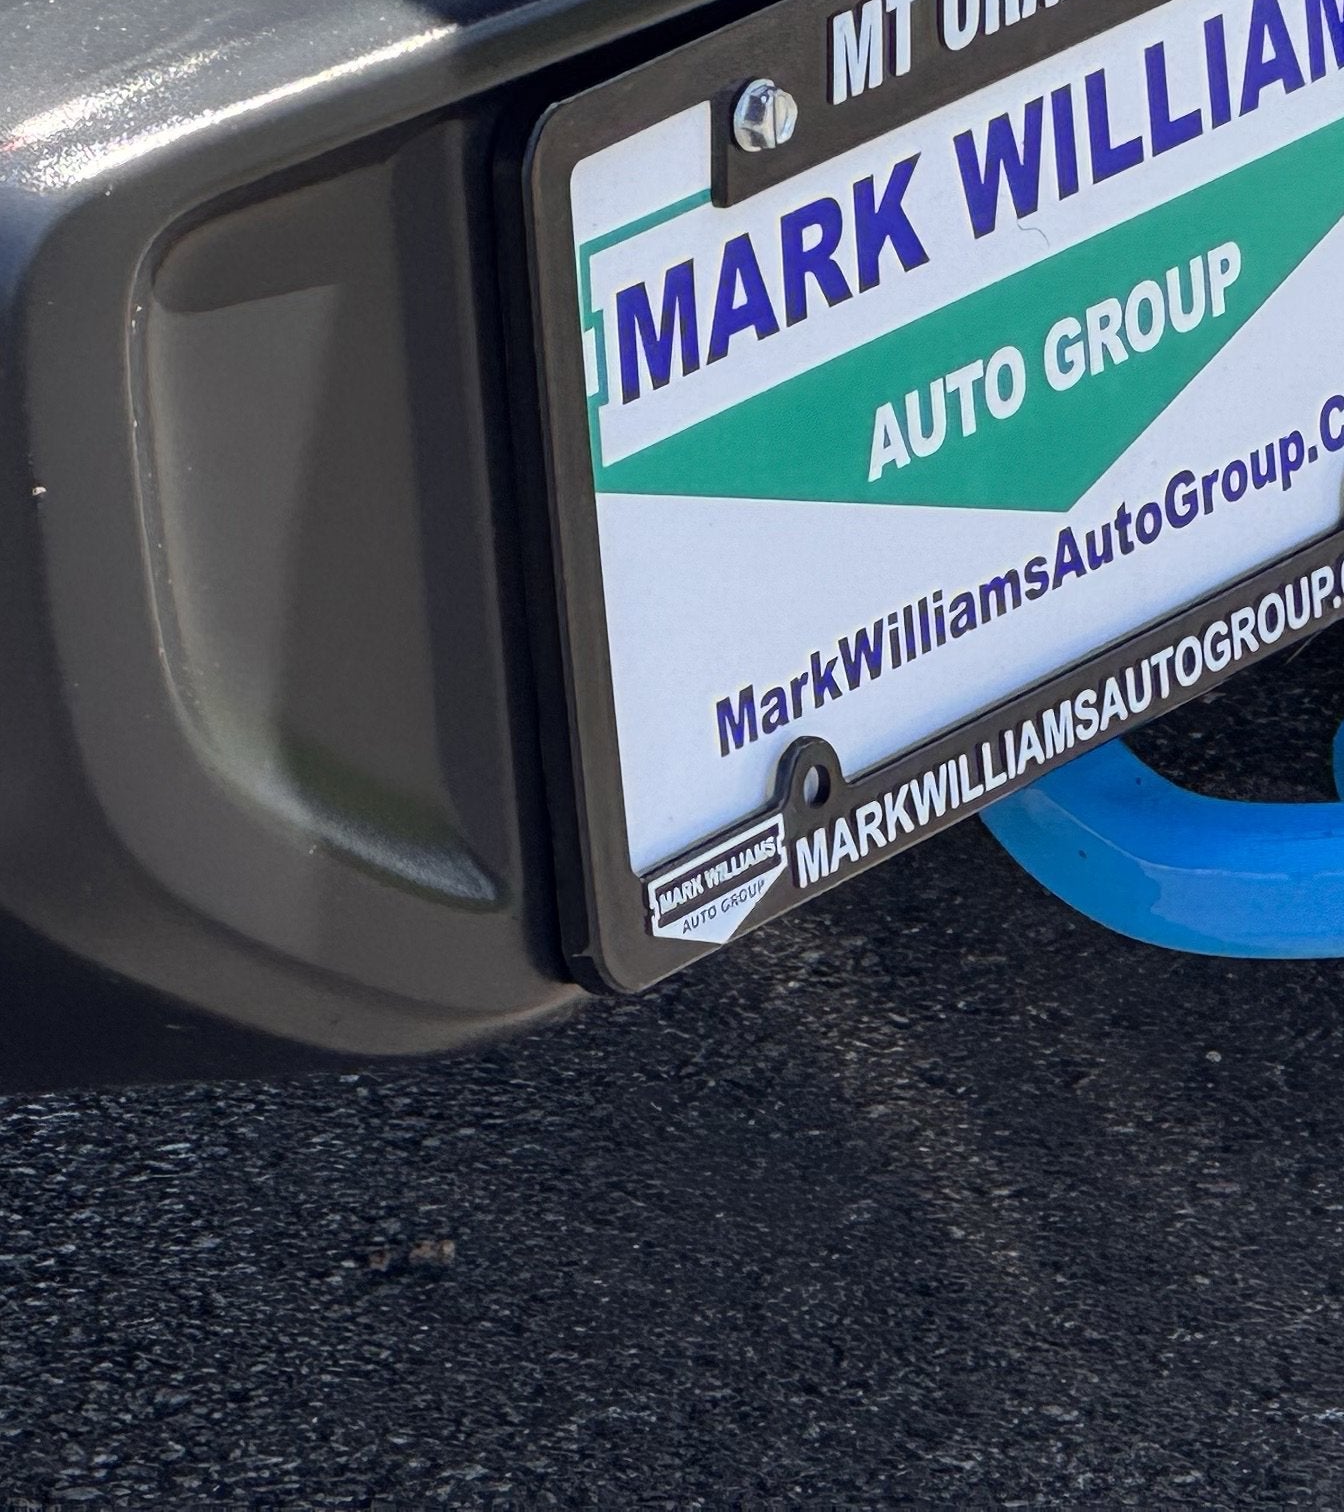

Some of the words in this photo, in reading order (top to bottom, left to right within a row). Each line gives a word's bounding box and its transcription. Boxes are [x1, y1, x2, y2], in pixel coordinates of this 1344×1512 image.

[612, 152, 930, 406] MARK
[866, 345, 1026, 483] AUTO
[1044, 241, 1241, 392] GROUP
[657, 873, 704, 915] MARK
[704, 836, 777, 889] WILLIAMS
[681, 904, 718, 935] AUTO
[720, 877, 766, 914] GROUP
